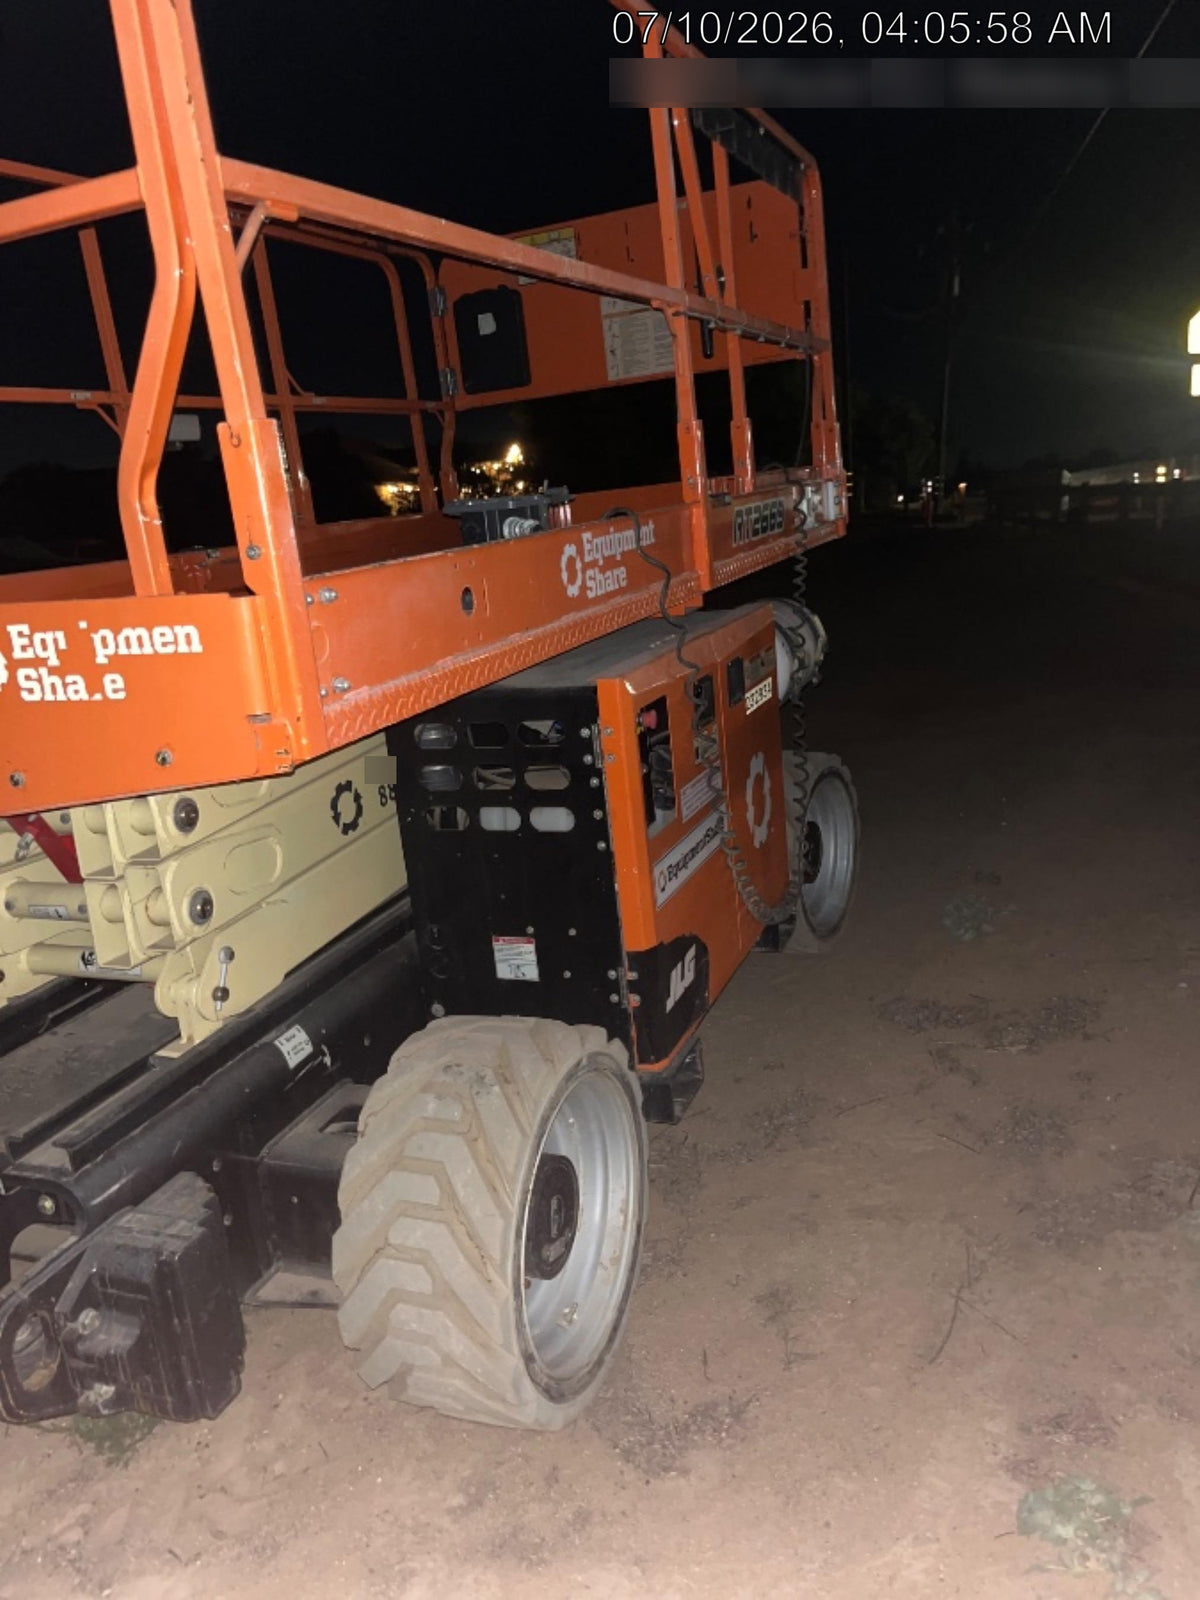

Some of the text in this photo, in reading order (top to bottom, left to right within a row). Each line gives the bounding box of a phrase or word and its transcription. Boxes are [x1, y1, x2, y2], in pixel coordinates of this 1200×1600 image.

[585, 566, 627, 599] Share
[16, 666, 126, 702] Shae
[665, 943, 697, 1015] JLG
